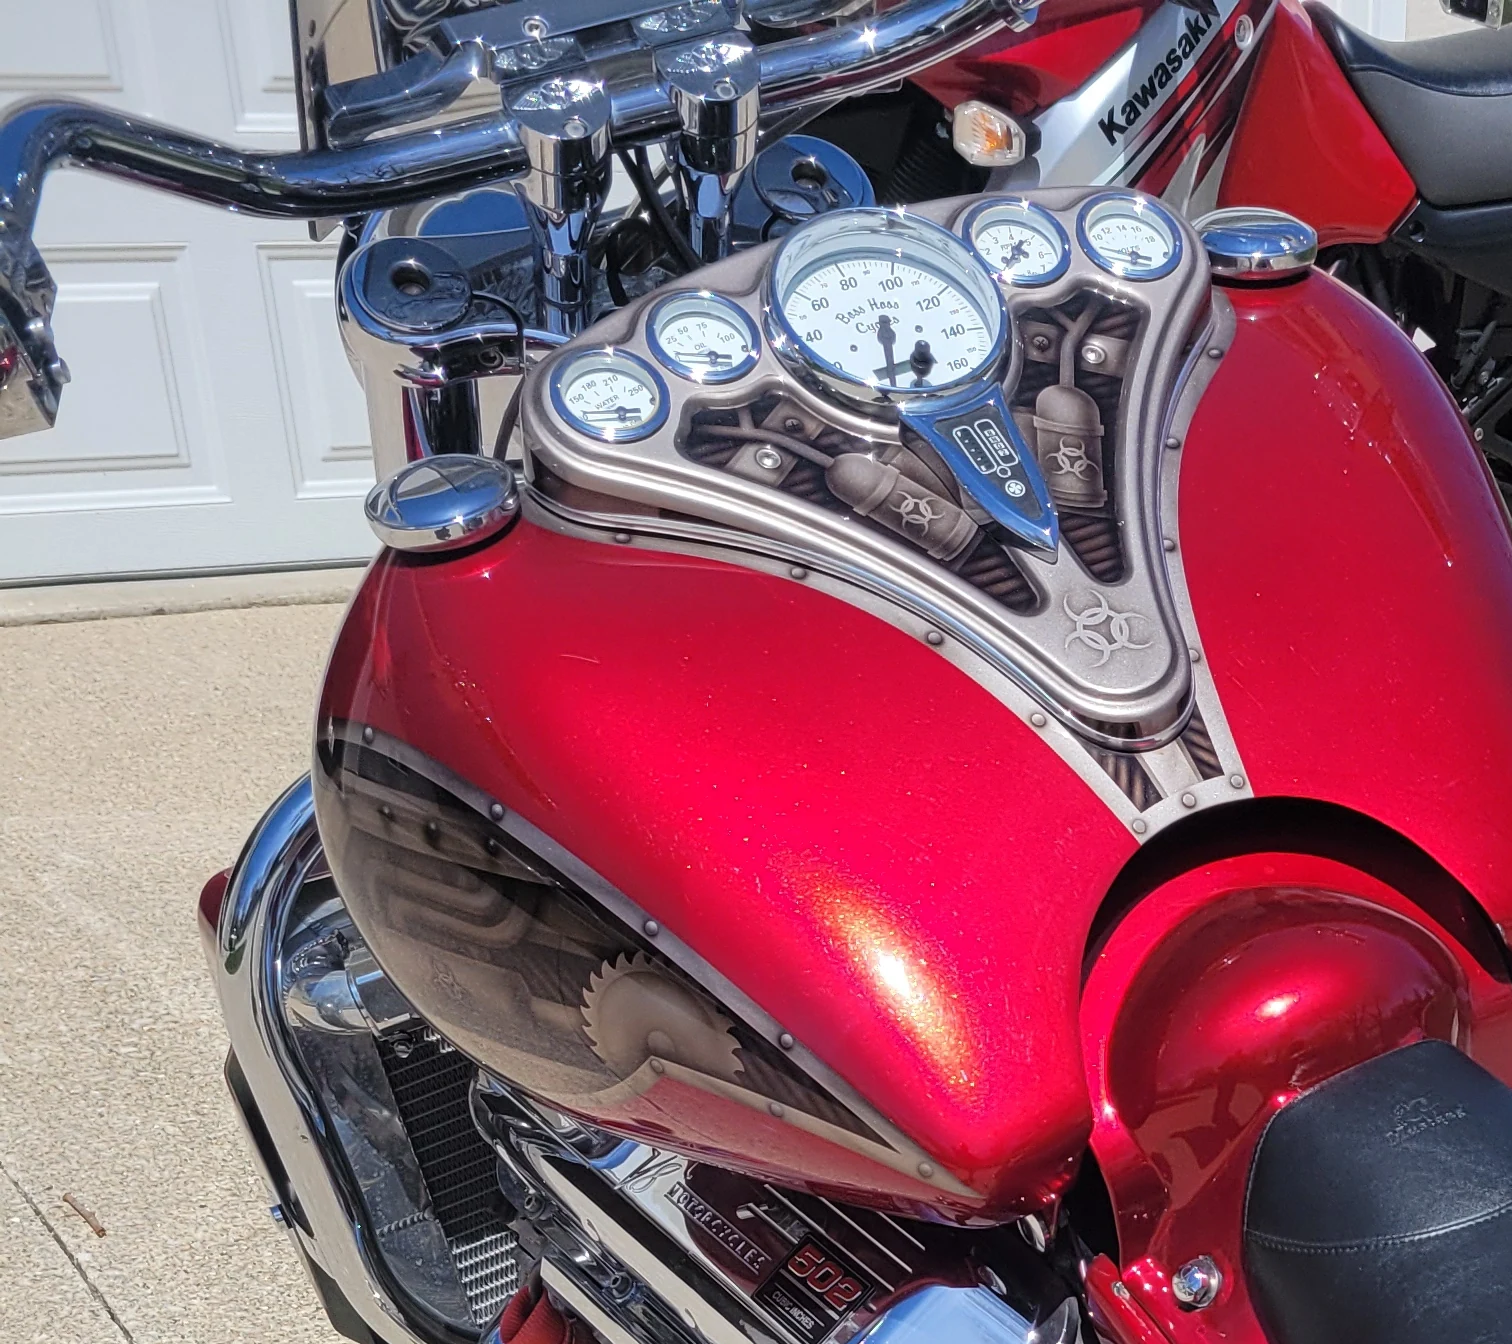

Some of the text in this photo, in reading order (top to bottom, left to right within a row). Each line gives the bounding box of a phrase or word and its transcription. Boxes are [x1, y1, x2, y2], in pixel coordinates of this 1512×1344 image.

[1101, 227, 1112, 235] 12
[1116, 224, 1127, 232] 14
[1130, 225, 1142, 234] 16
[992, 236, 999, 244] 3
[1091, 233, 1103, 242] 10
[1144, 235, 1156, 244] 18
[985, 248, 992, 256] 2
[1038, 251, 1045, 259] 6
[839, 276, 858, 291] 80
[878, 276, 904, 293] 100
[811, 297, 830, 312] 60
[915, 296, 941, 312] 120
[835, 297, 900, 325] Boss Hoss
[677, 325, 689, 336] 50
[696, 321, 708, 331] 75
[855, 315, 900, 334] Cycs
[719, 332, 736, 344] 100
[805, 329, 823, 343] 40
[940, 324, 966, 340] 140
[665, 335, 678, 345] 25
[694, 342, 707, 351] OIL
[947, 357, 969, 372] 160
[581, 380, 597, 392] 180
[602, 374, 619, 387] 210
[628, 384, 645, 397] 250
[568, 393, 585, 405] 150
[594, 394, 620, 411] WATER
[666, 1184, 768, 1271] MOTORCYCLES
[787, 1244, 863, 1312] 502
[789, 1305, 815, 1331] INCHES
